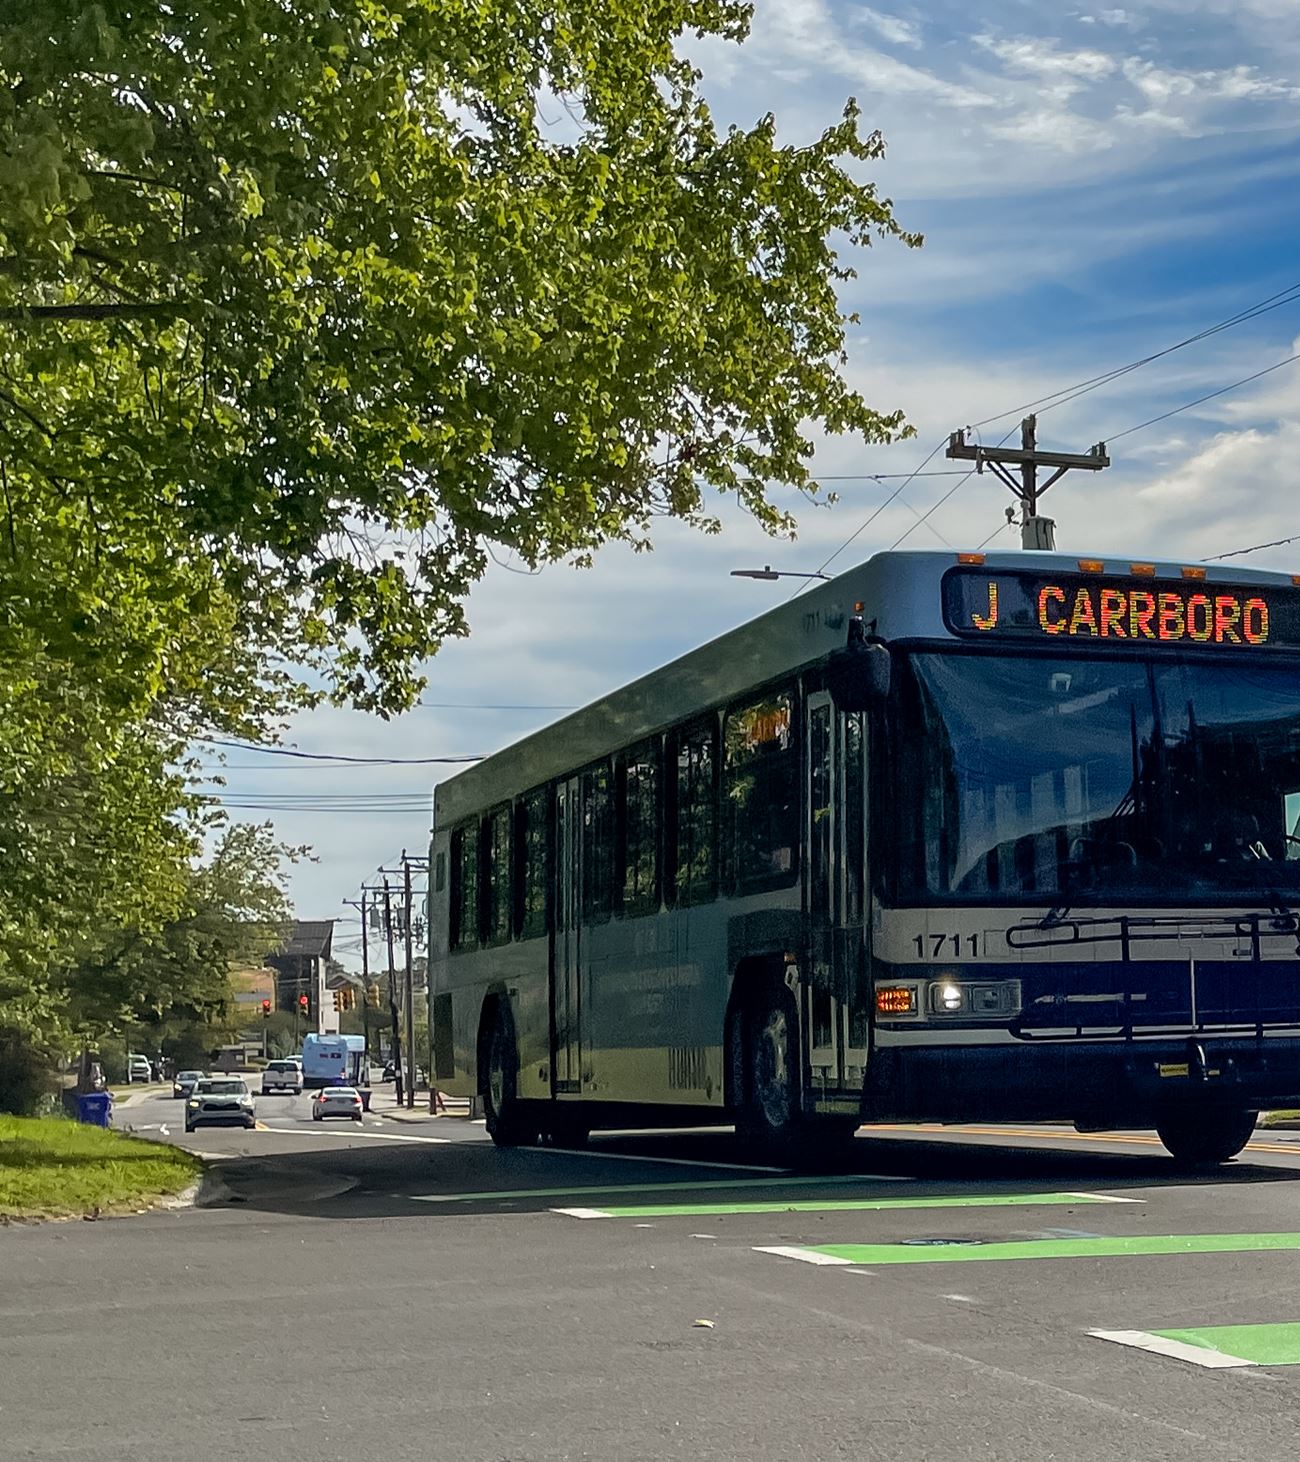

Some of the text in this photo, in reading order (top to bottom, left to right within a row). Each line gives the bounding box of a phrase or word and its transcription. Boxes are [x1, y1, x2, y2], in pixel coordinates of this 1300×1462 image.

[972, 581, 1270, 645] J CARRBORO
[912, 933, 979, 958] 1711
